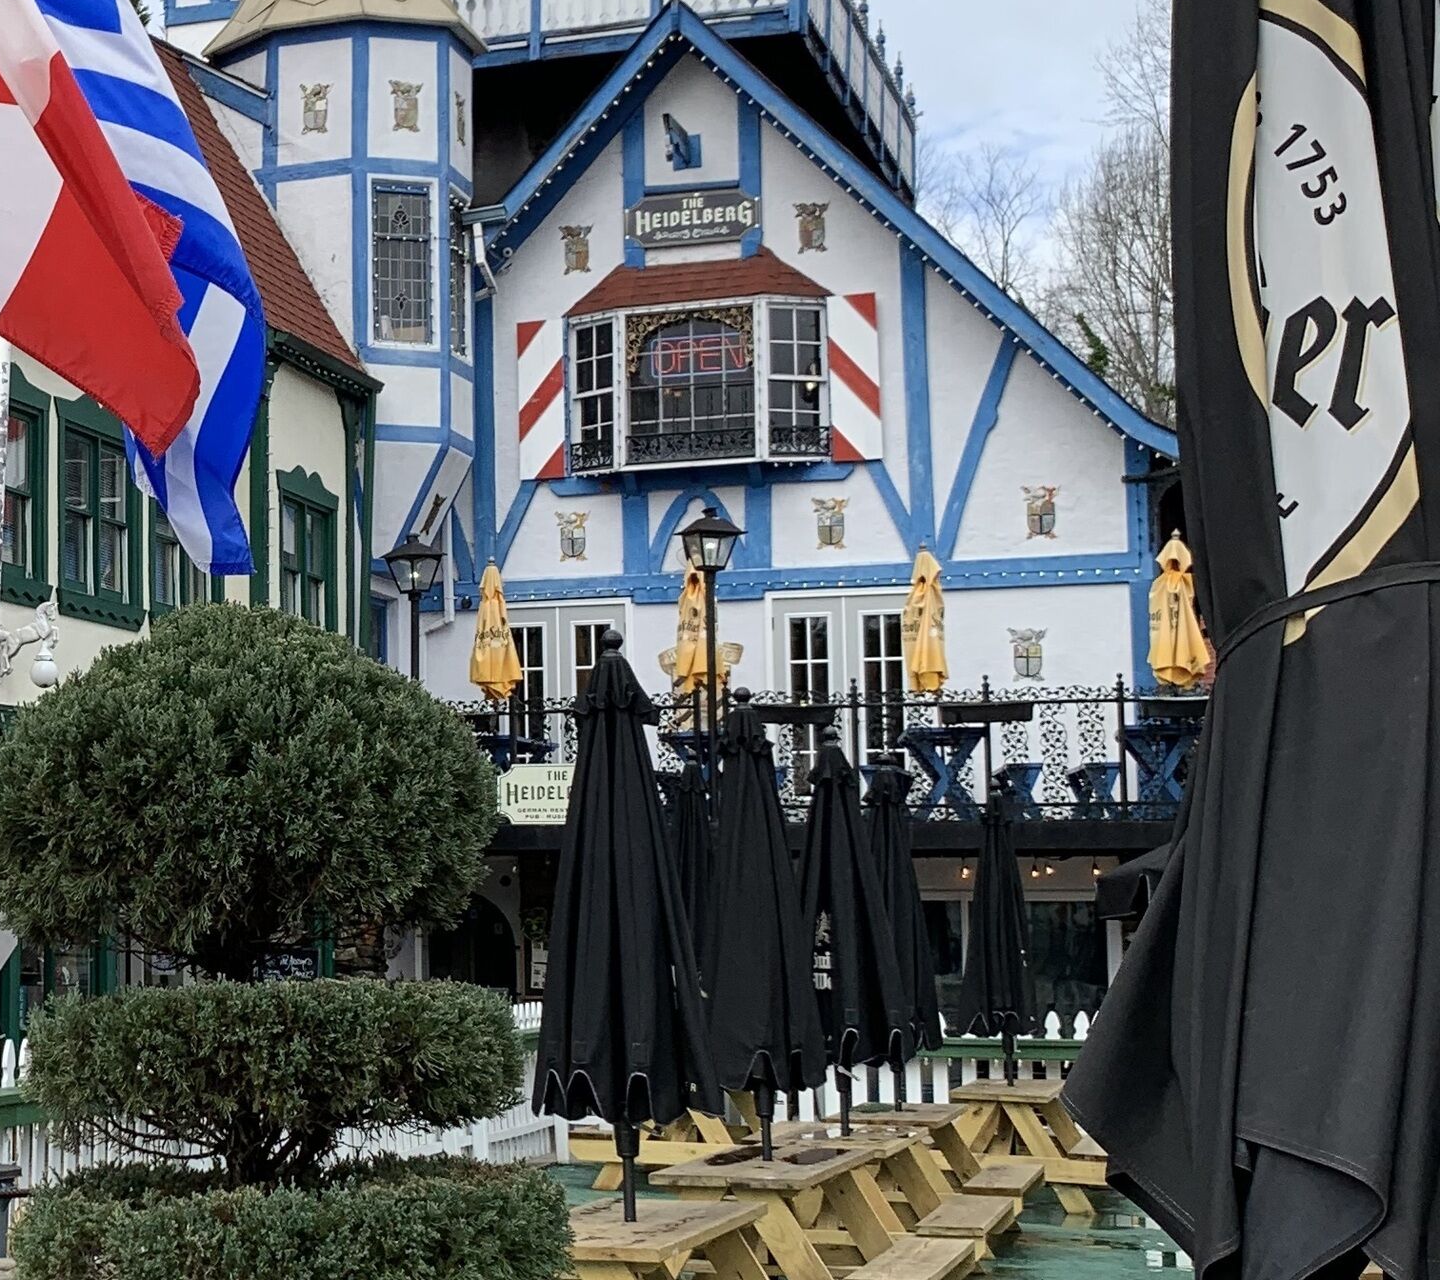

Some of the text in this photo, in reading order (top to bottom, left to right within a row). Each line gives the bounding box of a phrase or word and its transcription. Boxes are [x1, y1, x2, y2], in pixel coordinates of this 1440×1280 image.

[1274, 122, 1347, 227] 1753
[634, 200, 753, 236] HEIDELBERG
[681, 196, 705, 209] THE
[654, 334, 746, 374] OPEN
[1263, 295, 1397, 432] er
[547, 770, 568, 781] THE
